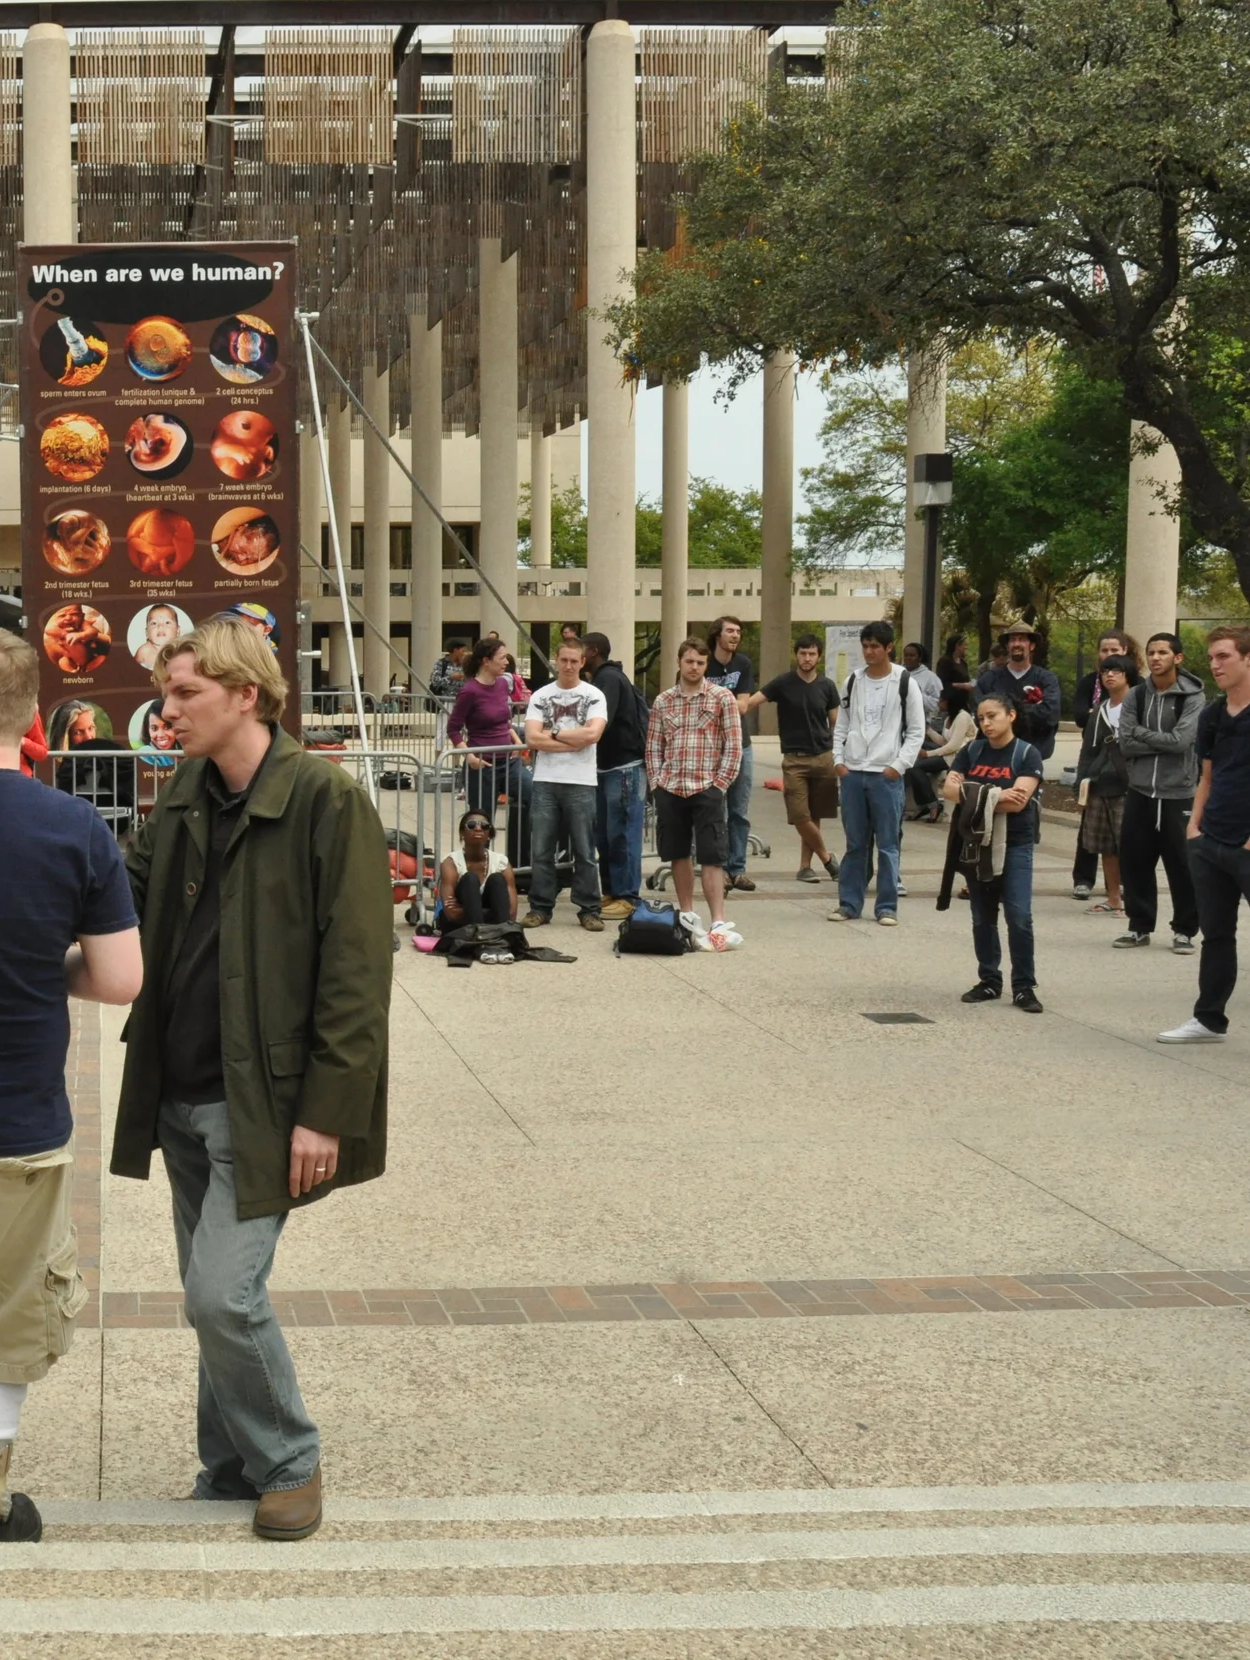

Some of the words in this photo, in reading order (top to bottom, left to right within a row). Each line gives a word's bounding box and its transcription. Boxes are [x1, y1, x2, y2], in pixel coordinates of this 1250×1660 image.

[32, 265, 97, 283] When
[105, 267, 142, 283] are
[149, 266, 184, 282] we
[192, 262, 285, 281] human?
[40, 390, 62, 398] sperm
[121, 388, 160, 396] fertilization
[161, 388, 188, 397] (unique
[222, 387, 235, 395] cell
[236, 388, 274, 396] conceptus
[115, 398, 147, 406] complete
[174, 397, 205, 406] genome)
[230, 397, 242, 405] (24
[243, 396, 259, 405] hrs.)
[39, 485, 82, 494] implantation
[83, 485, 91, 493] (6
[92, 485, 111, 493] days)
[139, 484, 159, 492] week
[160, 484, 187, 493] embryo
[219, 483, 224, 491] 7
[225, 483, 245, 491] week
[245, 483, 272, 492] embryo
[126, 493, 163, 502] (heartbeat
[172, 493, 178, 501] 3
[178, 493, 195, 502] wks)
[208, 492, 251, 501] (brainwaves
[252, 492, 260, 500] at
[260, 492, 266, 500] 6
[267, 492, 284, 500] wks)
[44, 581, 57, 589] 2nd
[175, 579, 193, 587] fetus
[214, 579, 242, 588] partially
[244, 579, 260, 587] born
[74, 590, 92, 598] wks.)
[147, 589, 158, 597] (35
[158, 589, 176, 597] wks)
[62, 676, 94, 684] newborn
